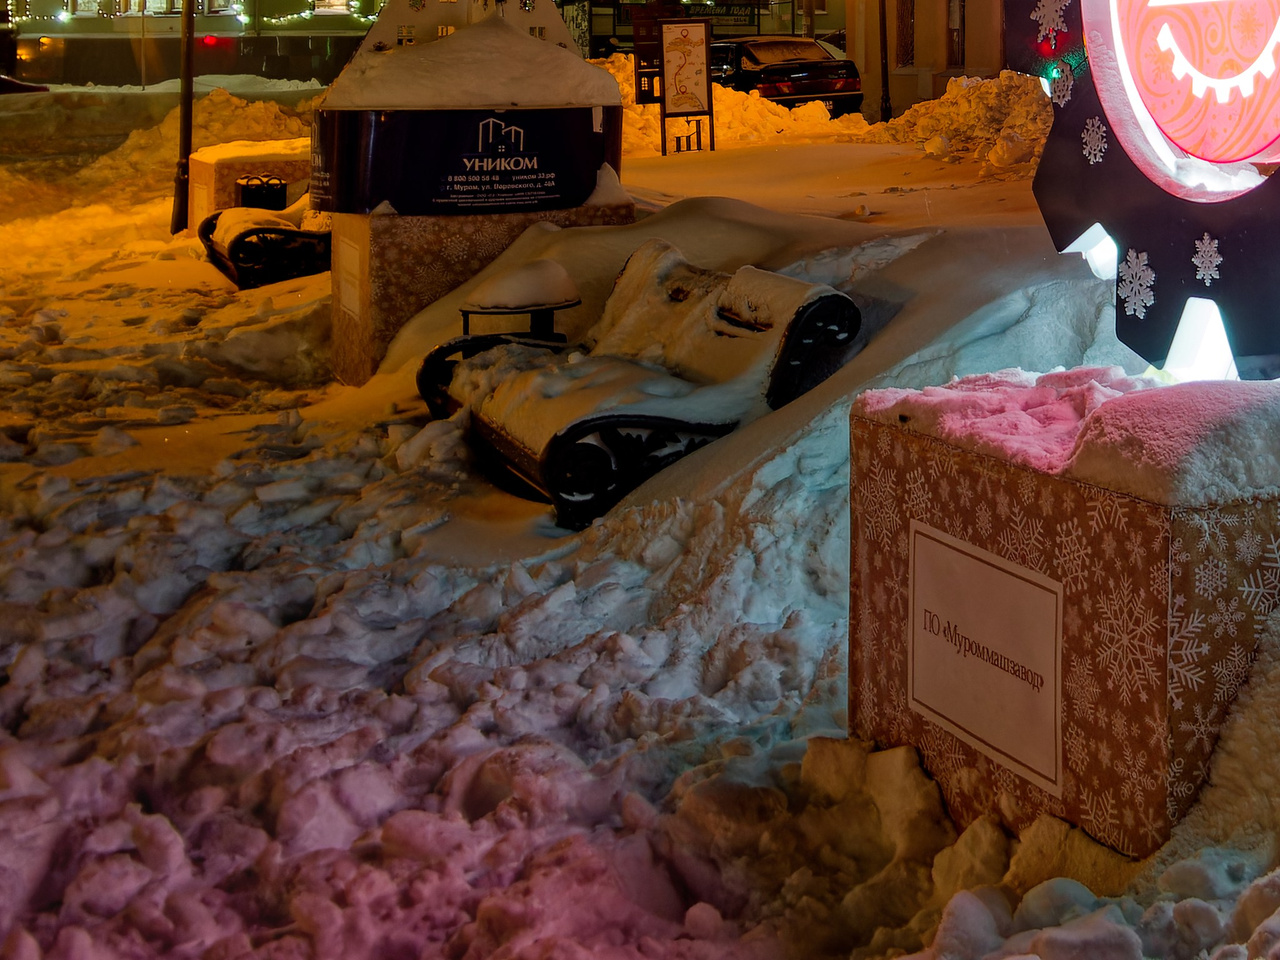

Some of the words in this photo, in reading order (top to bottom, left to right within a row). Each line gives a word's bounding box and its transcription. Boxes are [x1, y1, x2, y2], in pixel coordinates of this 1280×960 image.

[463, 157, 538, 171] УНИКОМ
[923, 609, 940, 636] ПО
[942, 620, 1044, 693] «Муроммашзавод»
